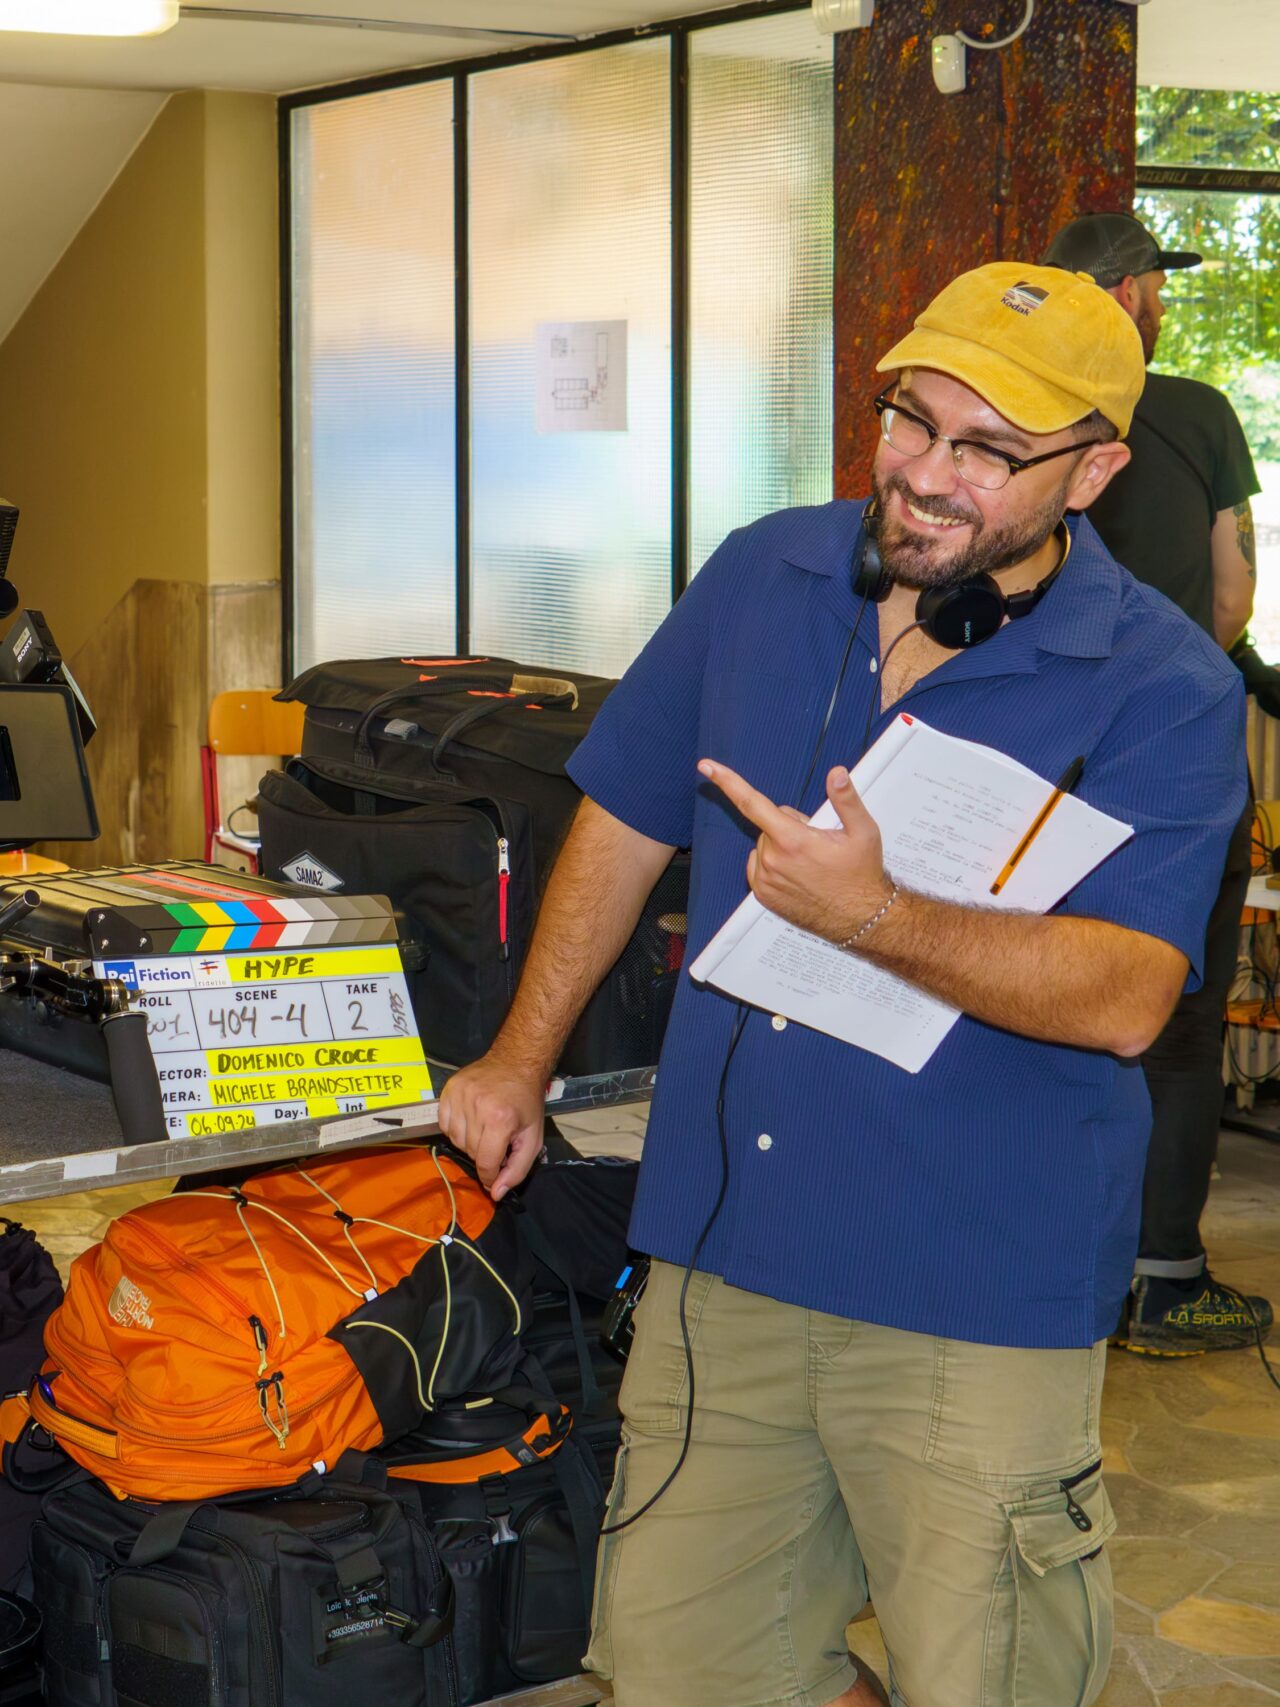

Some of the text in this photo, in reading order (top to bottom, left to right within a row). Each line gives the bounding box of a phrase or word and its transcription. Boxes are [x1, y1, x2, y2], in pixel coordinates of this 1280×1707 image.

[1000, 296, 1031, 317] Kodak
[17, 637, 34, 662] SONY
[139, 968, 191, 982] Fiction
[244, 957, 314, 979] HYPE
[235, 989, 278, 1001] SCENE
[346, 983, 378, 995] TAKE
[139, 996, 172, 1007] ROLL
[348, 1000, 368, 1031] 2
[217, 1047, 379, 1073] DOMENICO CROCE
[213, 1074, 403, 1105] MICHELE BRANDSTETTER
[130, 1287, 152, 1310] FACE
[113, 1309, 134, 1328] THE
[126, 1297, 154, 1329] NORTH
[1167, 1311, 1255, 1326] LA SPORTIV
